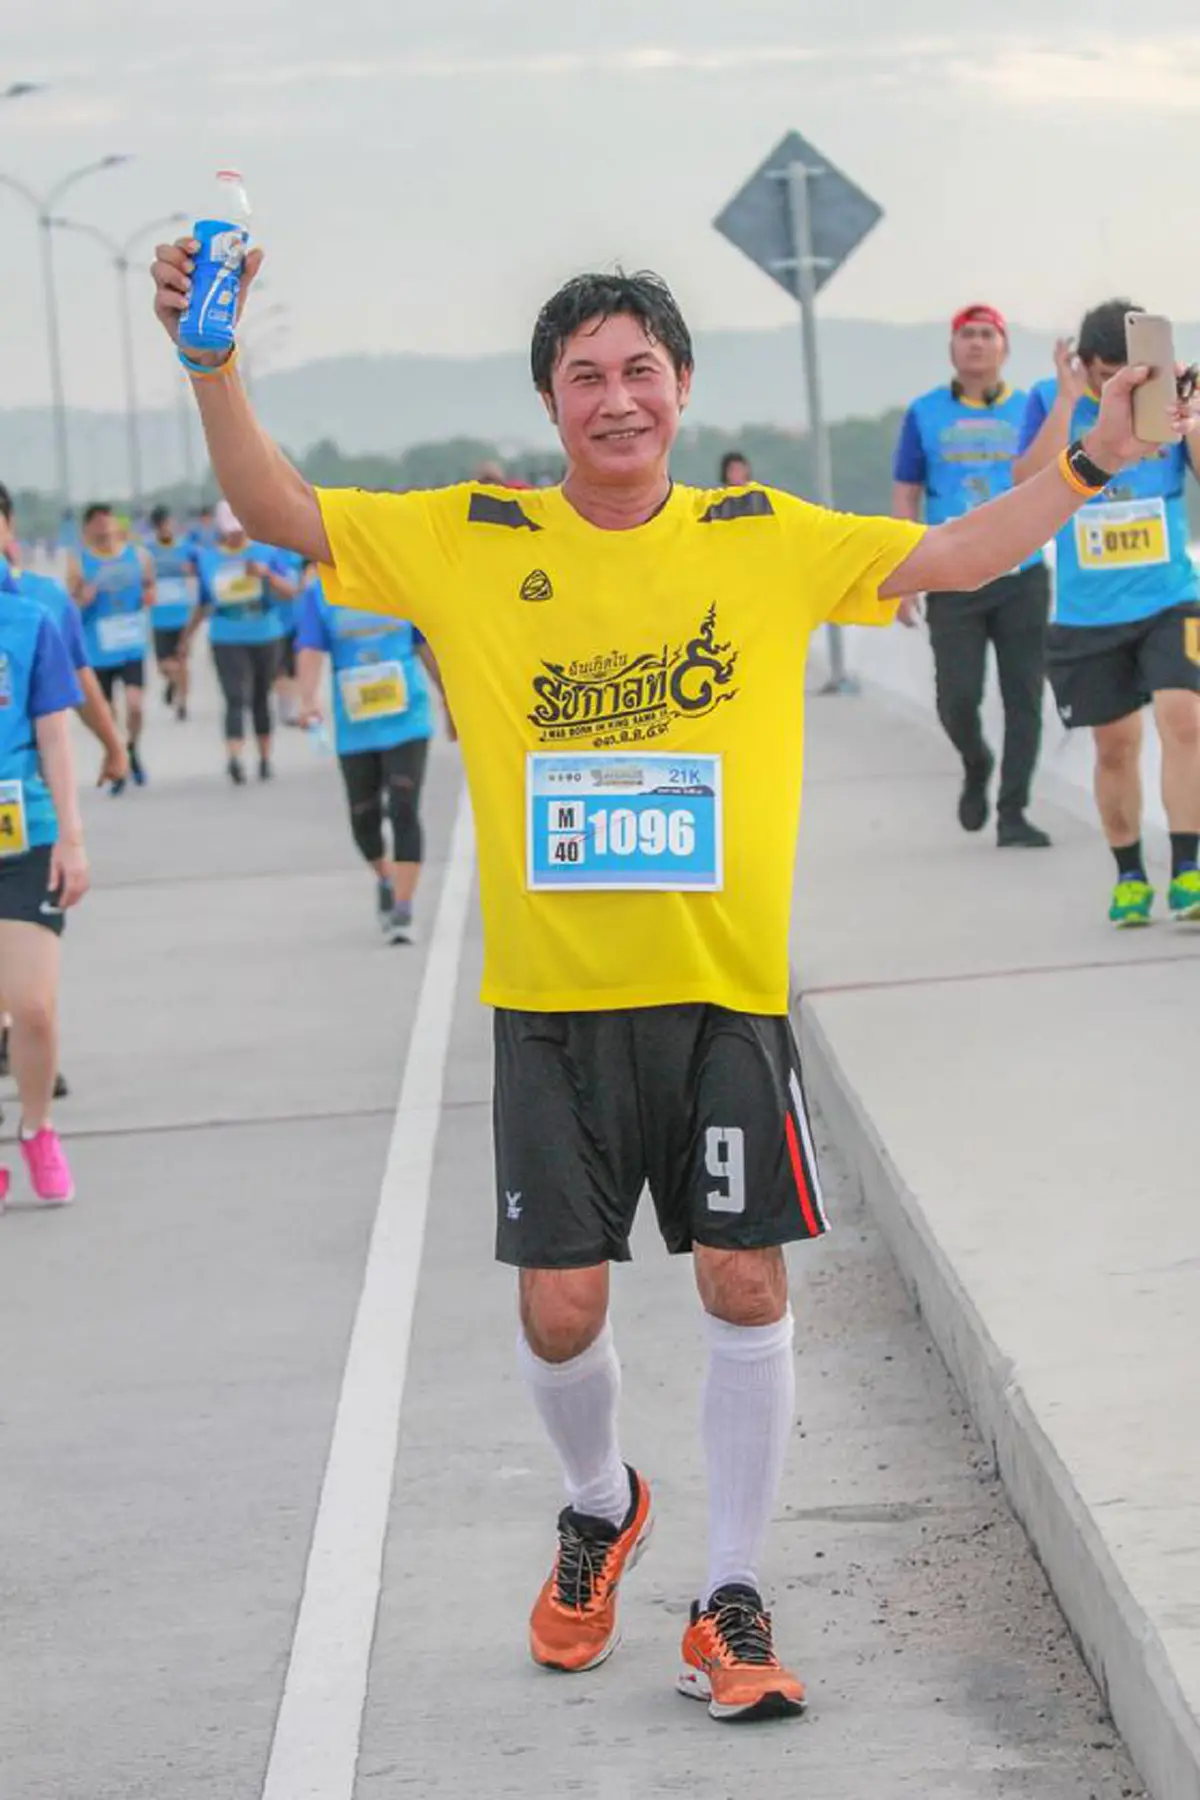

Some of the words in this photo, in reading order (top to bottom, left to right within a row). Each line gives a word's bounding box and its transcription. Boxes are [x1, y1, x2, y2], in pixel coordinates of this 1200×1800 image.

[569, 723, 593, 737] BORN
[596, 722, 606, 733] IN
[608, 717, 630, 731] KING
[633, 713, 656, 727] RAMA
[669, 769, 700, 784] 21K
[558, 808, 575, 829] M
[587, 808, 695, 856] 1096
[555, 841, 579, 862] 40
[705, 1126, 745, 1214] 9
